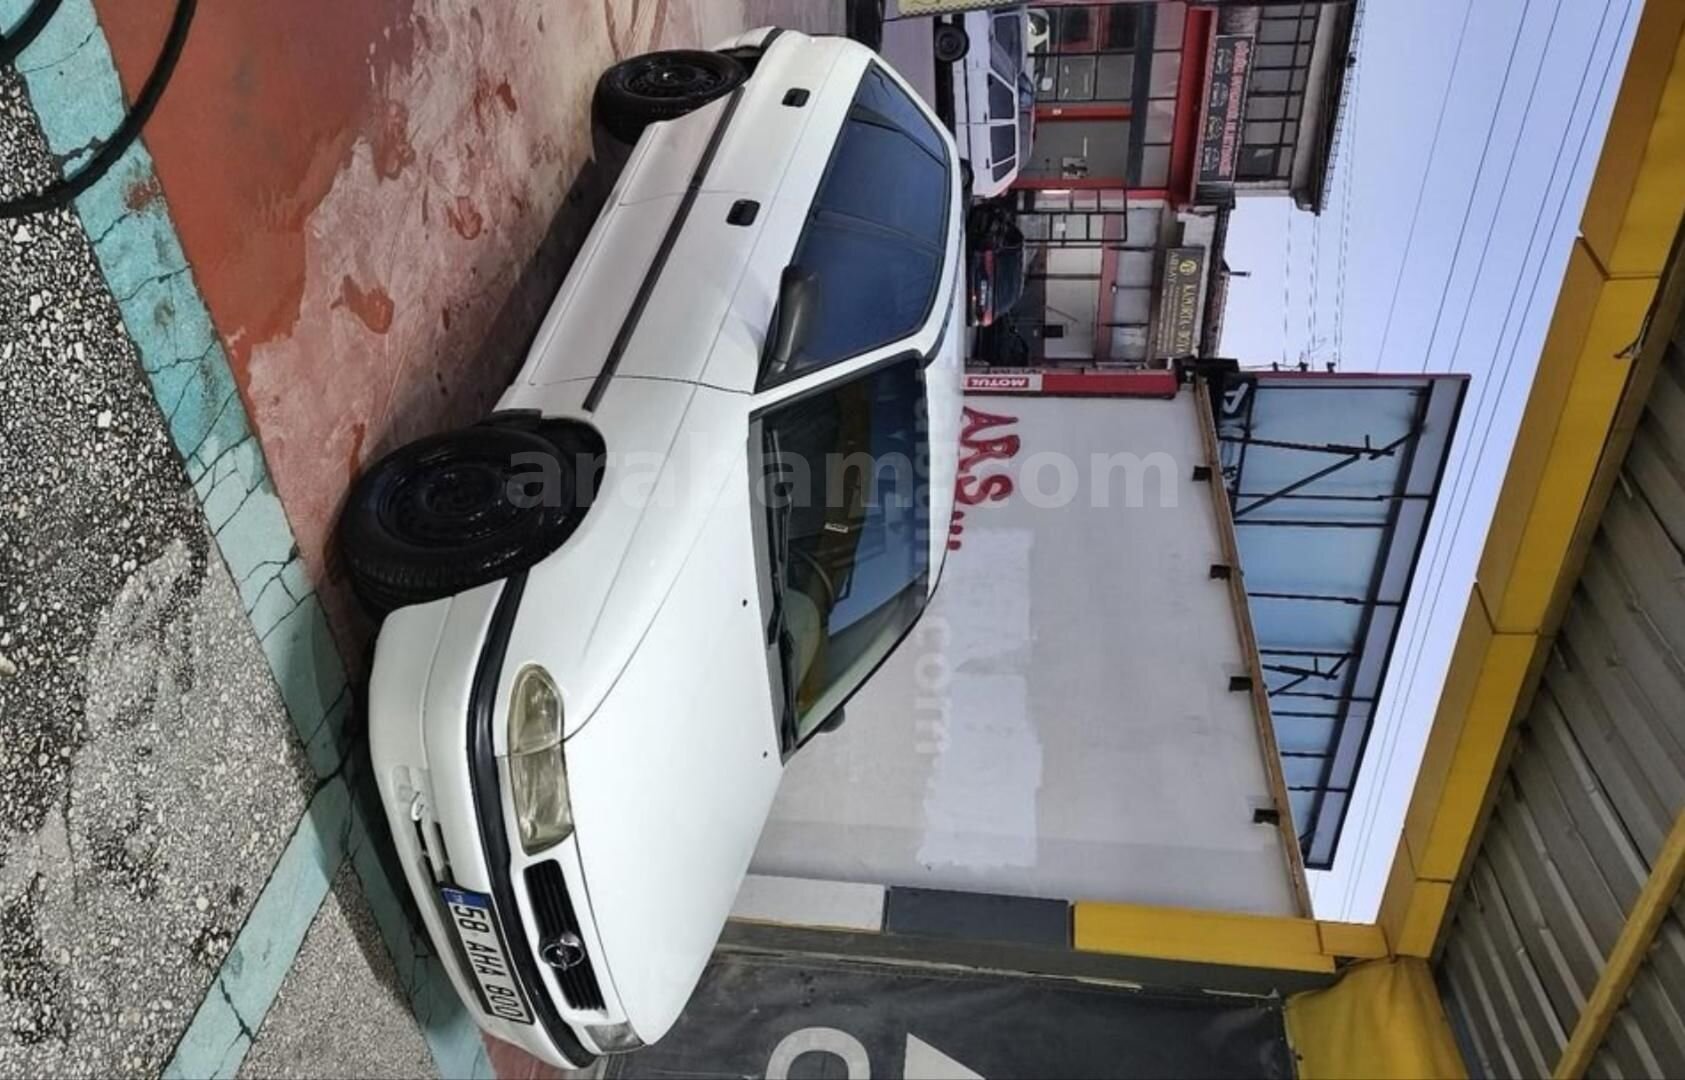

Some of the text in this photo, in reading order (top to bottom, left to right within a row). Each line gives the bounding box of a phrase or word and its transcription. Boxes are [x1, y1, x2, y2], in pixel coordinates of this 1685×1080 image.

[970, 377, 1027, 388] MOTUL
[454, 905, 524, 1018] 58 AHA 800
